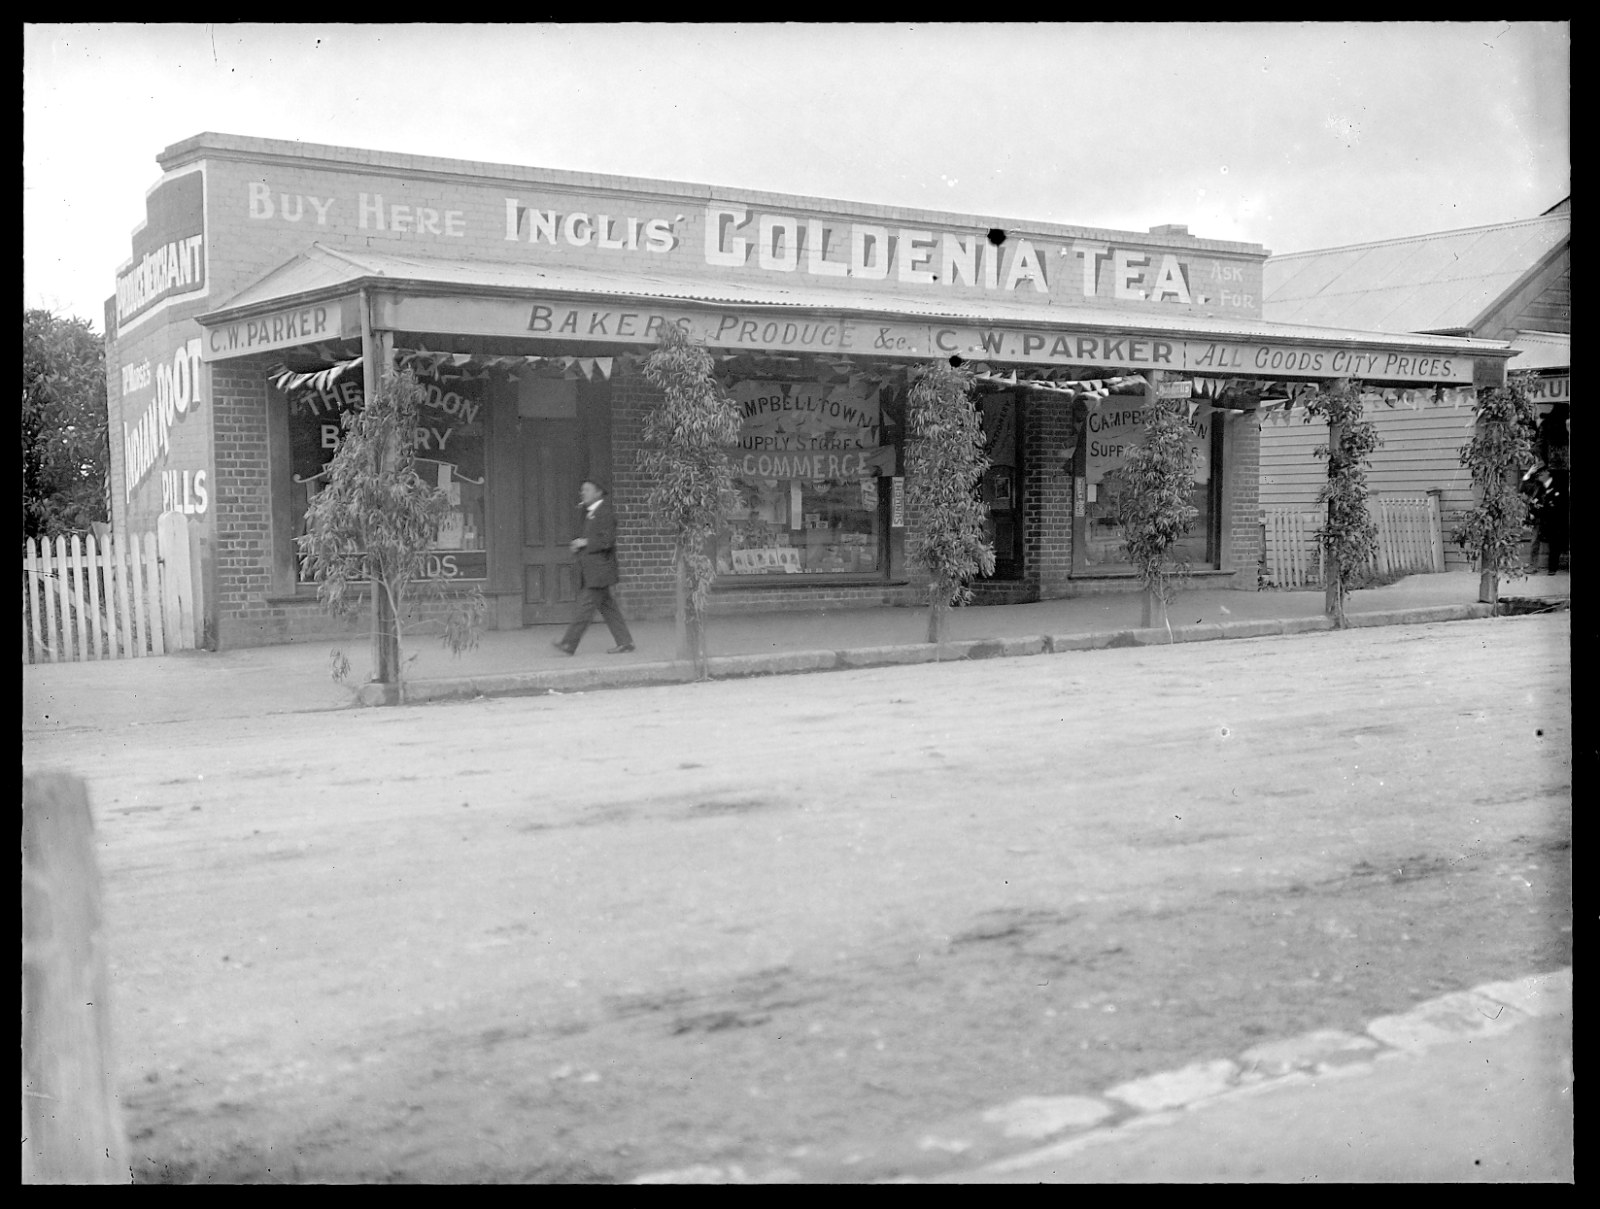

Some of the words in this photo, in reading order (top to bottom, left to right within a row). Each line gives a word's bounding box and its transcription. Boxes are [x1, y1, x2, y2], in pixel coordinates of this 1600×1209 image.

[248, 181, 335, 225] BUY
[359, 192, 467, 237] HERE
[704, 202, 1050, 294] GOLDENIA
[1210, 262, 1243, 282] ASK
[1220, 289, 1256, 309] FOR
[714, 313, 856, 348] PRODUCE
[1194, 343, 1243, 368] ALL
[1254, 346, 1324, 371] GOODS
[1331, 350, 1380, 375] CITY
[1383, 353, 1457, 377] PRICES.
[300, 381, 362, 416] THE
[738, 395, 873, 428] AMPBELLTOWN
[123, 396, 158, 504] INDIAN
[155, 338, 202, 456] ROOT
[321, 424, 453, 450] BRY
[737, 435, 790, 451] UPPLY
[742, 451, 872, 479] COMMERCE
[162, 469, 208, 514] PILLS
